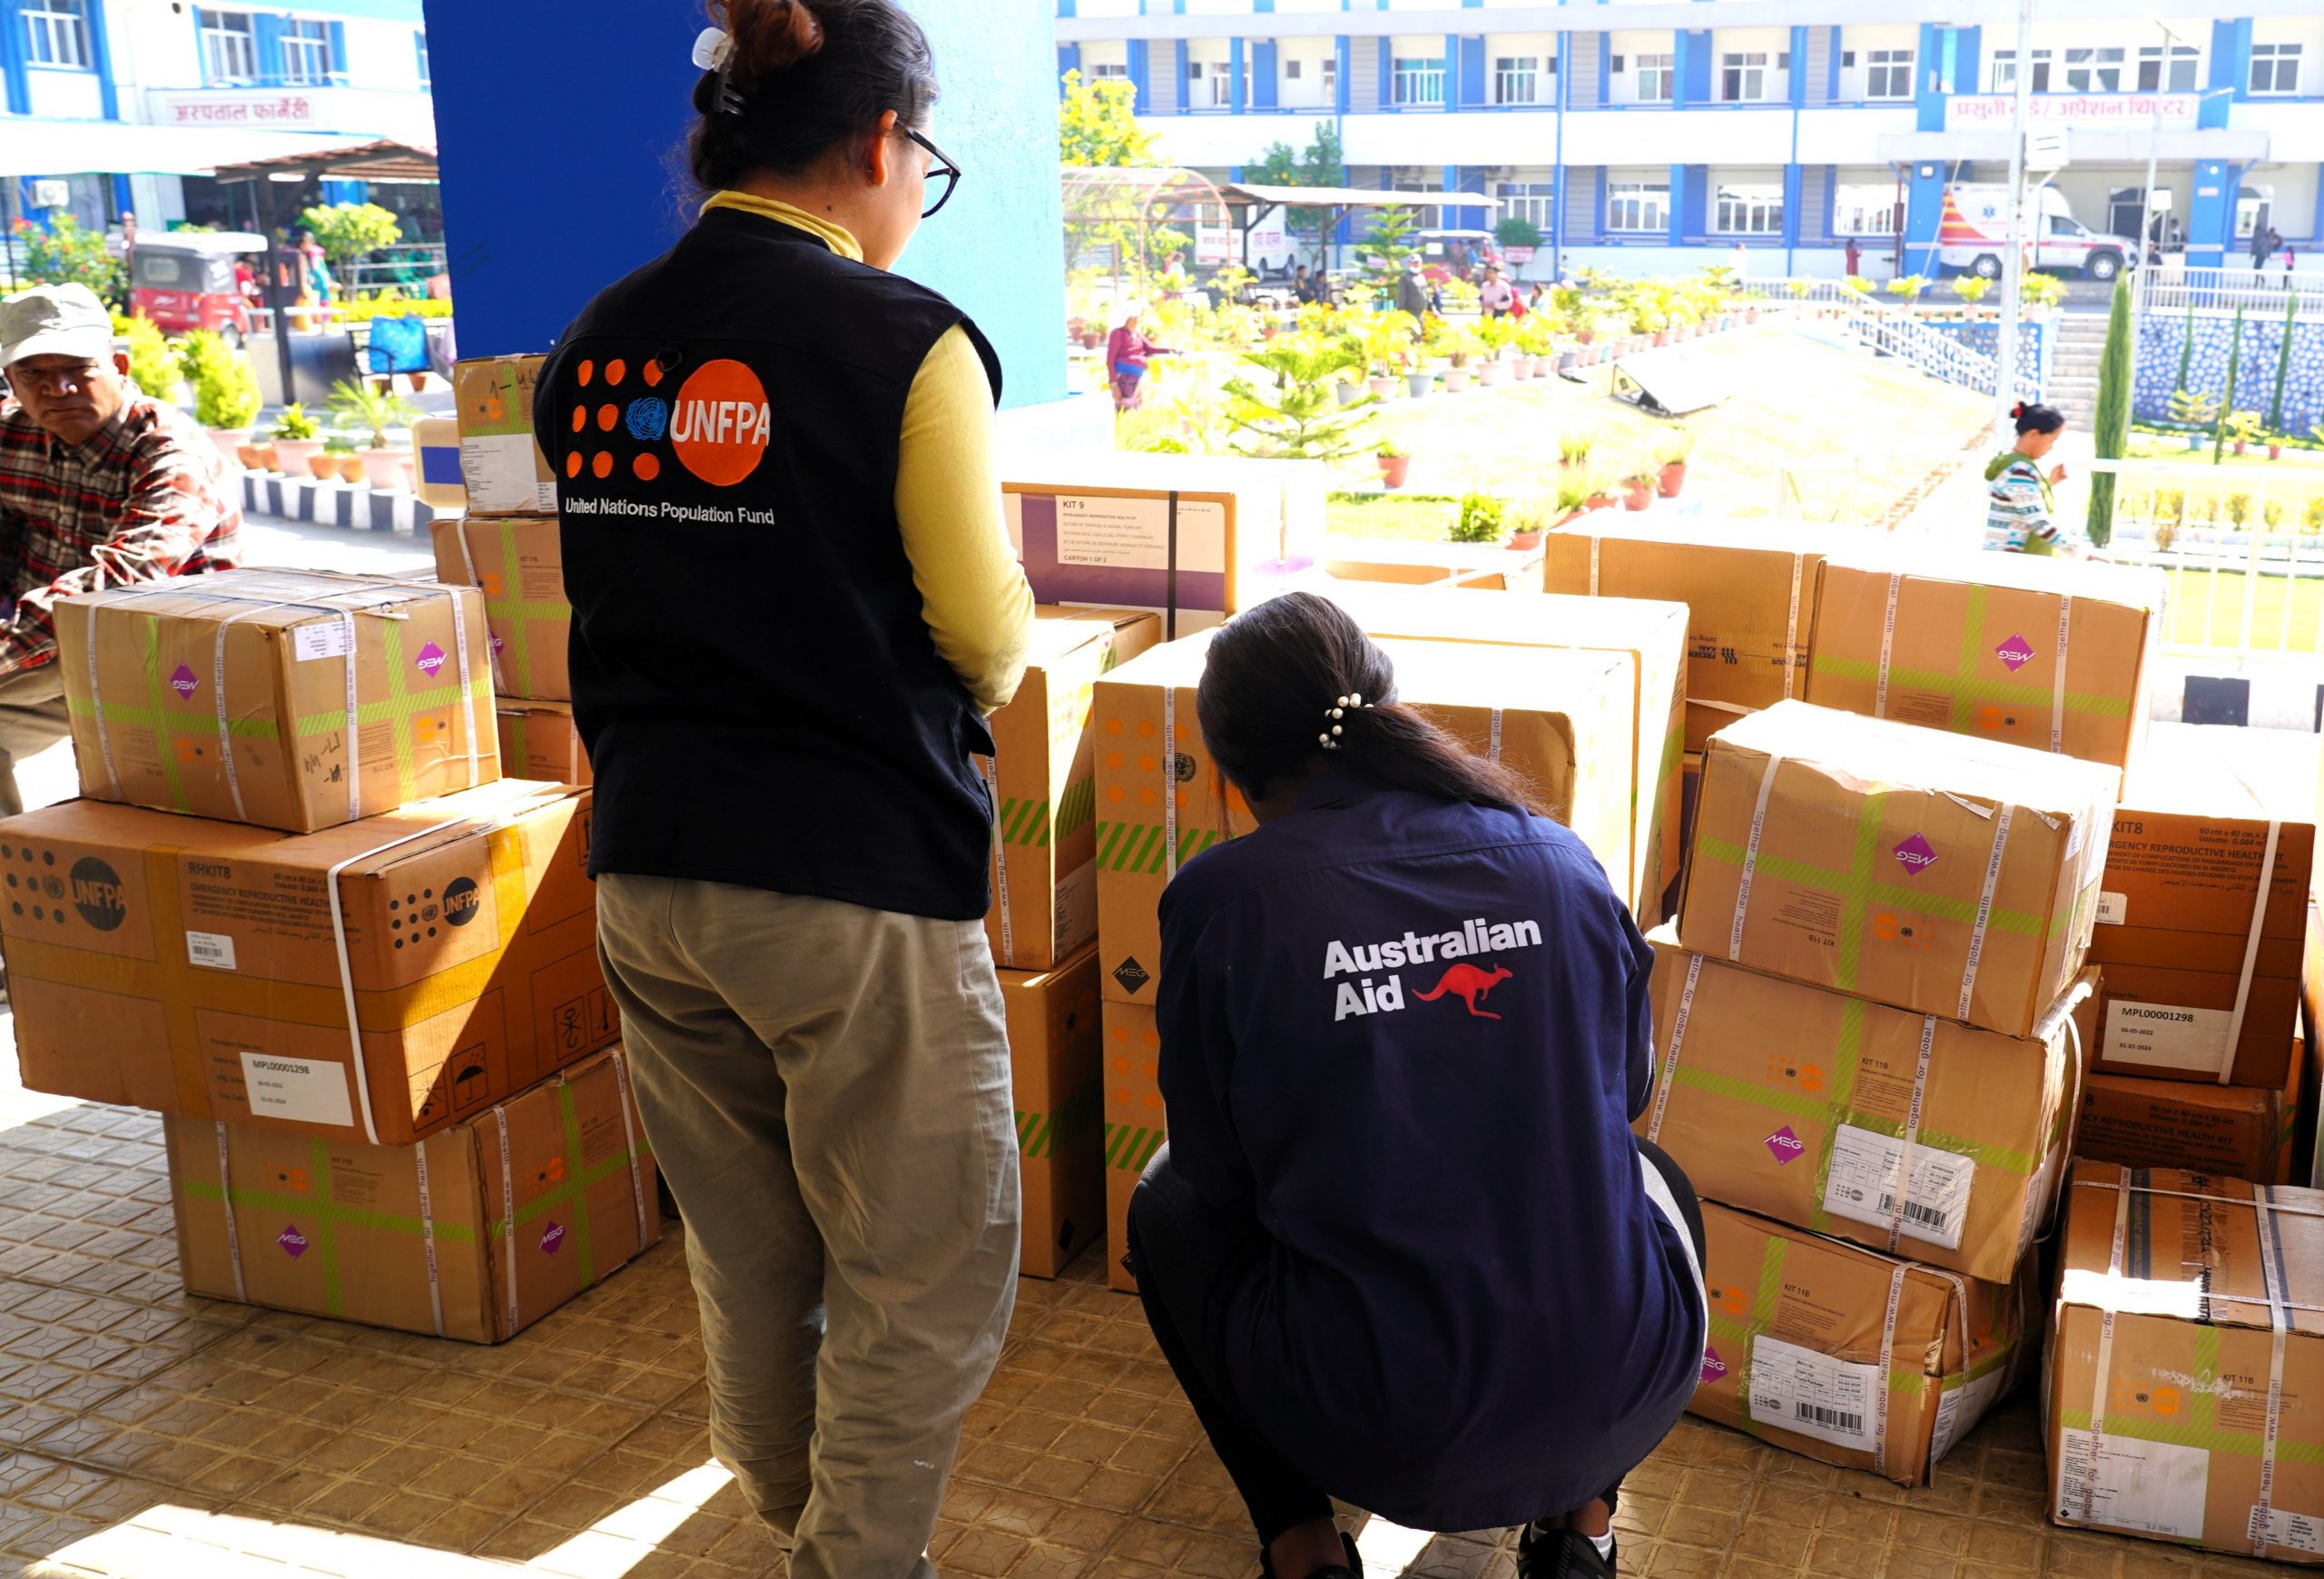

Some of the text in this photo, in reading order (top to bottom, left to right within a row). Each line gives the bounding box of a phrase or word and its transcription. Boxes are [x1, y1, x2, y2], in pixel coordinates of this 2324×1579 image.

[669, 399, 772, 447] UNFPA
[566, 498, 775, 526] United Nations Population Fund
[1062, 500, 1085, 509] KIT 9
[1063, 555, 1088, 563] CARTON
[1790, 594, 1799, 621] health
[2061, 597, 2069, 611] for
[455, 597, 469, 697] health www.meg.nl
[1787, 624, 1797, 650] global
[1878, 575, 1899, 703] lobal health www.meg.nl
[418, 653, 448, 670] MEG
[1997, 649, 2035, 662] MEG
[172, 680, 200, 690] MEG
[348, 668, 356, 725] www.meg.nl
[217, 693, 226, 723] global
[1492, 709, 1502, 737] globa
[1166, 724, 1174, 753] health
[224, 749, 237, 786] together
[1166, 760, 1174, 790] global
[1167, 817, 1175, 855] together
[2199, 835, 2230, 844] Volume:
[2230, 829, 2240, 837] 40
[1896, 850, 1938, 866] MEG
[2142, 854, 2191, 863] COMPLICATIONS
[2150, 844, 2267, 860] REPRODUCTIVE HEALTH
[188, 863, 231, 880] RHKIT8
[1732, 811, 1764, 944] together for global health
[2133, 866, 2156, 874] CHARGE
[72, 878, 126, 911] UNFPA
[190, 883, 236, 897] EMERGENCY
[238, 889, 298, 905] REPRODUCTIVE
[444, 888, 480, 916] UNFPA
[996, 854, 1011, 951] health www.meg.nl
[1963, 814, 2010, 987] for global health www.meg.nl
[1323, 917, 1542, 980] Australian
[1807, 933, 1835, 947] KIT 11B
[1113, 967, 1147, 979] MEG
[1334, 974, 1405, 1022] Aid
[2121, 1007, 2194, 1022] MPL00001298
[2121, 1027, 2154, 1036] 06-05-2022
[1648, 953, 1703, 1142] gether for global health www.meg.n
[2119, 1042, 2152, 1051] 01-01-2024
[252, 1060, 310, 1074] MPL00001298
[1862, 1057, 1889, 1070] KIT 11B
[1908, 1026, 1933, 1130] together for global
[1764, 1134, 1803, 1150] MEG
[2100, 1114, 2233, 1145] REPRODUCTIVE HEALTH KIT
[418, 1158, 436, 1283] together for global health
[505, 1179, 513, 1237] www.meg.nl
[277, 1234, 307, 1245] MEG
[538, 1225, 564, 1250] MEG
[1784, 1283, 1810, 1298] KIT 11B
[1704, 1357, 1725, 1371] EG
[1876, 1271, 1902, 1439] for global health www.meg.n
[2222, 1374, 2254, 1385] KIT 11B
[2083, 1419, 2102, 1519] together for global
[2255, 1378, 2280, 1550] for global health www.meg.nl
